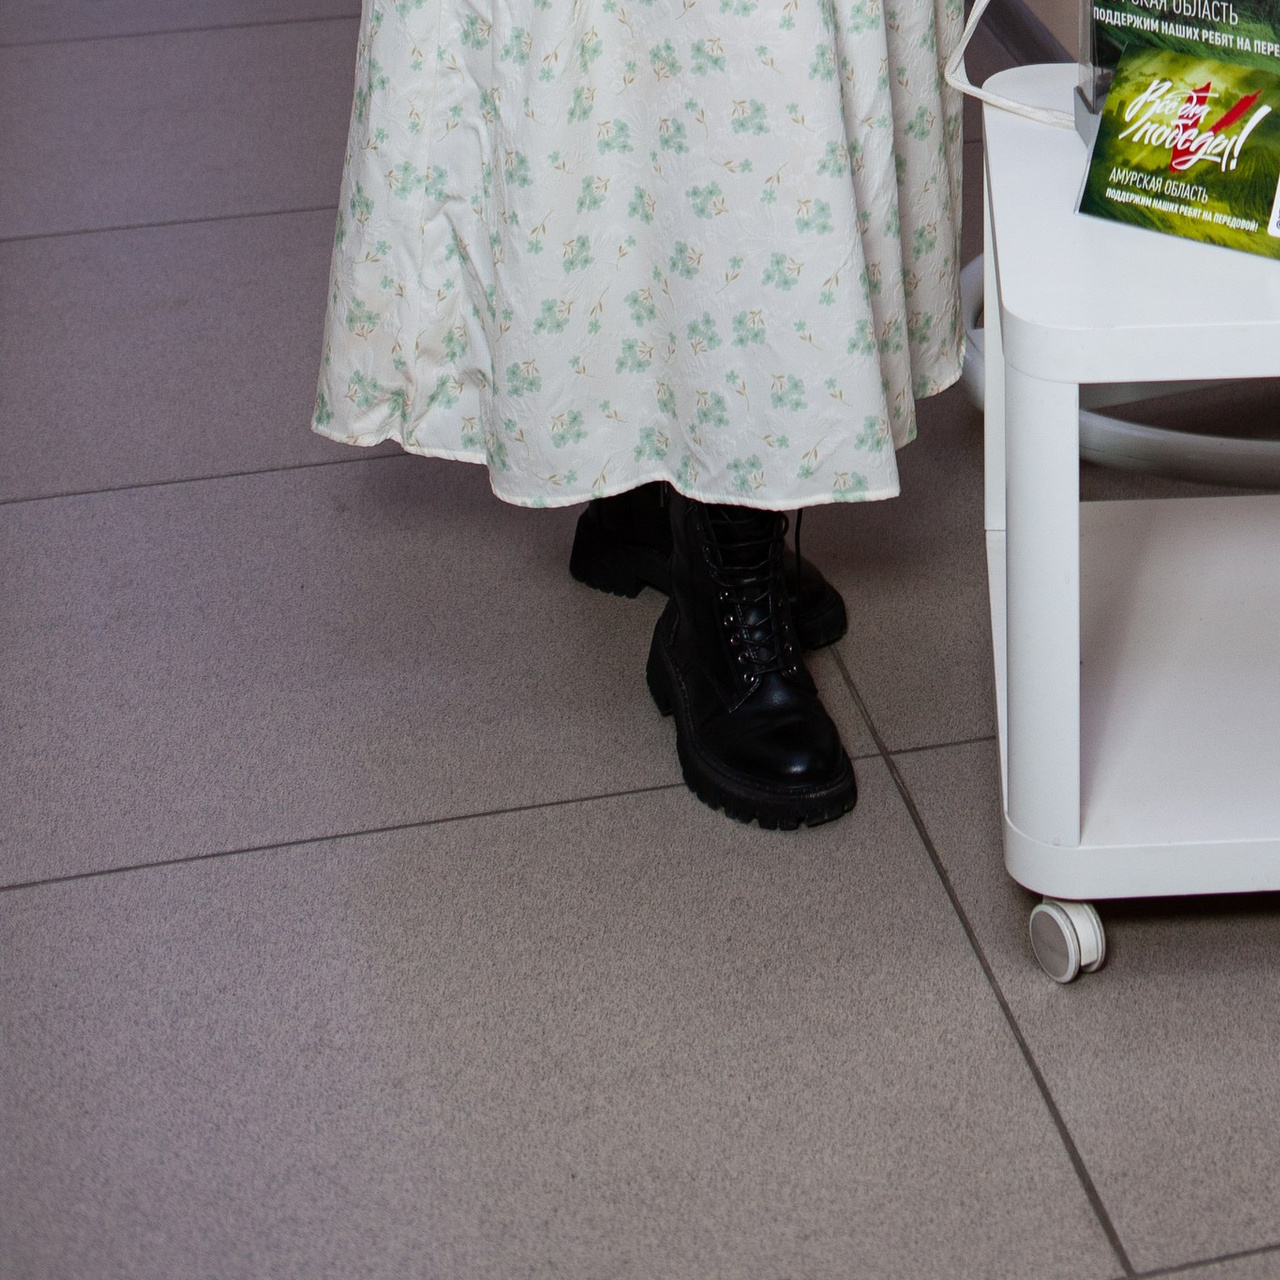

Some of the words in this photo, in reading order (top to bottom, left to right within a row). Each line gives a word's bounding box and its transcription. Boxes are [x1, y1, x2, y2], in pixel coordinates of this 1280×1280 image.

[1093, 6, 1159, 33] ПОДДЕРЖИМ
[1161, 21, 1200, 41] НАШИХ
[1202, 29, 1234, 49] РЕБЯТ
[1237, 36, 1251, 52] НА
[1163, 90, 1219, 124] для
[1109, 167, 1163, 194] АМУРСКАЯ
[1164, 181, 1209, 204] ОБЛАСТЬ
[1106, 187, 1152, 208] ПОДДЕРЖИМ
[1152, 198, 1179, 214] НАШИХ
[1178, 204, 1201, 218] РЕБЯТ
[1201, 209, 1212, 221] НА
[1213, 212, 1259, 233] ПЕРЕДОВОЙ!
